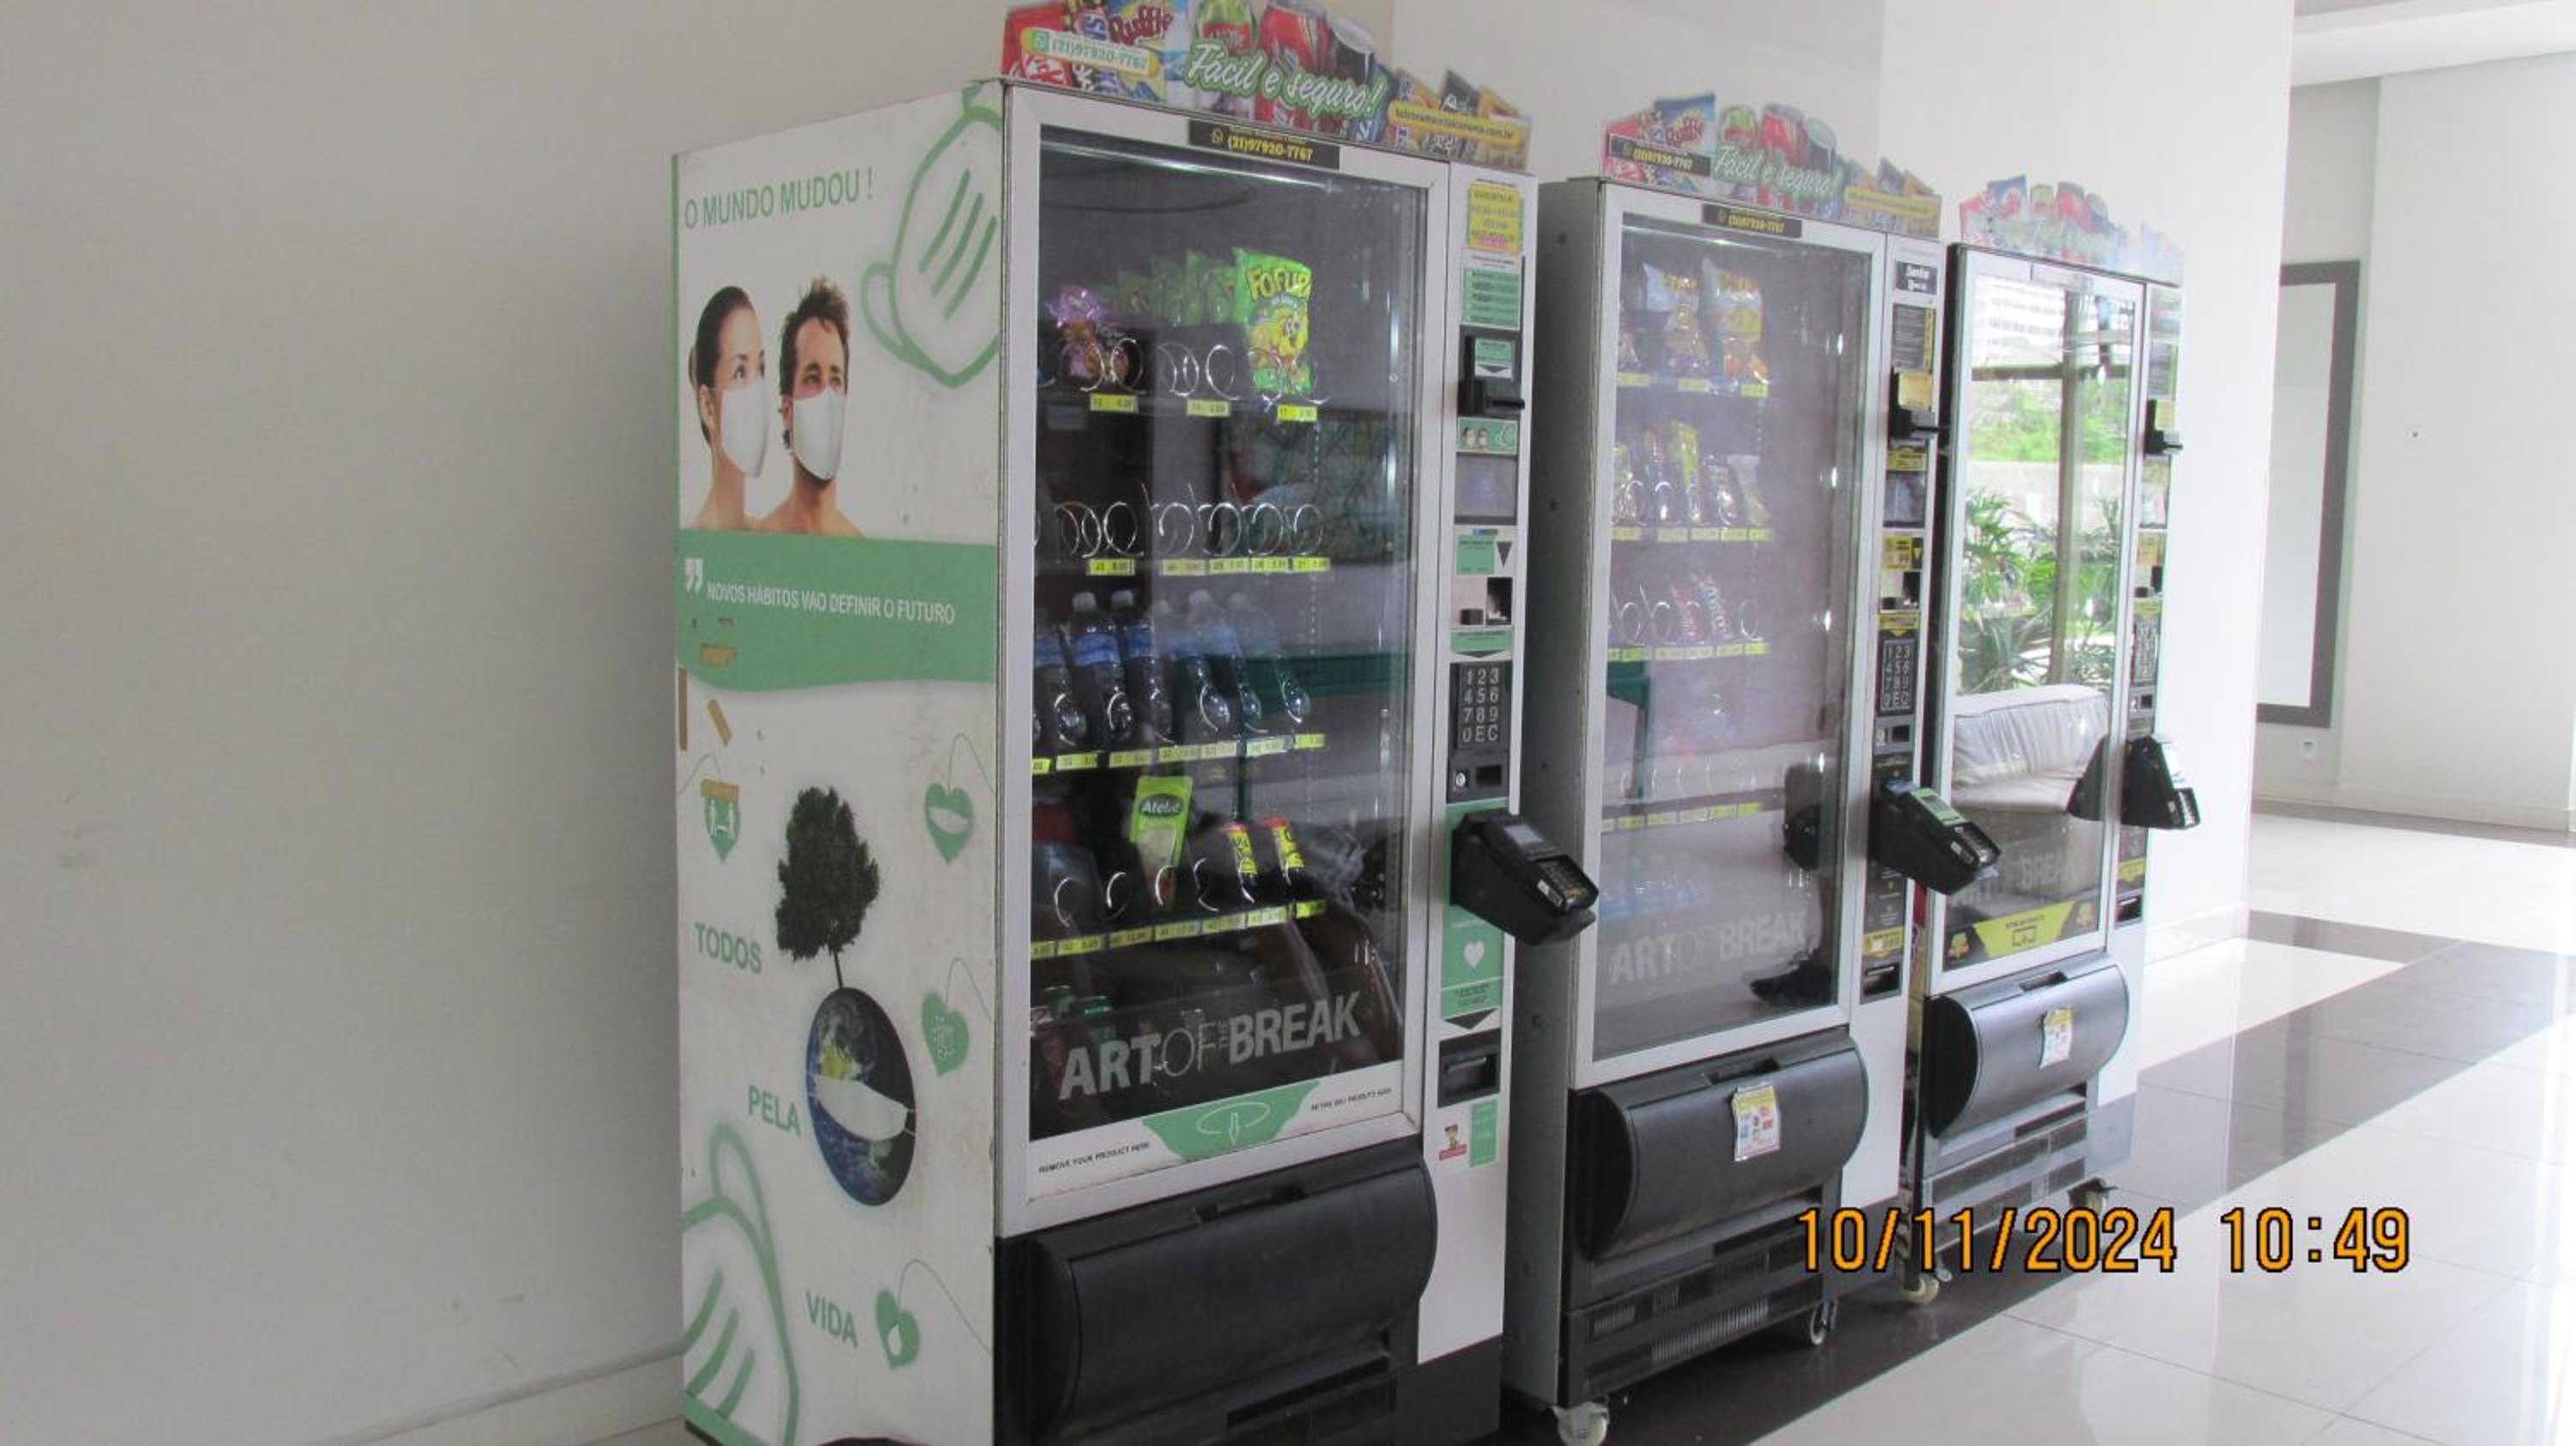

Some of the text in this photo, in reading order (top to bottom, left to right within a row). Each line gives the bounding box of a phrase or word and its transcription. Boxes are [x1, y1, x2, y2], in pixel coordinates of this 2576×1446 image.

[1186, 42, 1387, 115] Fácil e seguro!
[1227, 135, 1314, 161] (21)97920-7767
[1715, 145, 1764, 178] Fácil
[1777, 165, 1843, 194] seguro!
[684, 198, 698, 229] O
[702, 185, 775, 228] MUNDO
[780, 168, 860, 214] MUDOU
[706, 580, 745, 604] NOVOS
[746, 583, 798, 609] HÁBITOS
[829, 592, 882, 617] DEFINIR
[883, 598, 895, 618] O
[896, 599, 957, 625] FUTURO
[1464, 687, 1499, 704] 4 5 6
[1466, 666, 1499, 684] 1 2 3
[1463, 706, 1498, 723] 7 8 9
[1474, 726, 1485, 743] E
[693, 922, 763, 975] TODOS
[1607, 933, 1674, 984] ART
[1720, 908, 1807, 963] BREAK
[1058, 1032, 1161, 1101] ART
[1160, 1022, 1216, 1078] OF
[1229, 991, 1362, 1066] BREAK
[747, 1083, 802, 1139] PELA
[1037, 1159, 1072, 1174] REMOVE
[804, 1290, 858, 1348] VIDA
